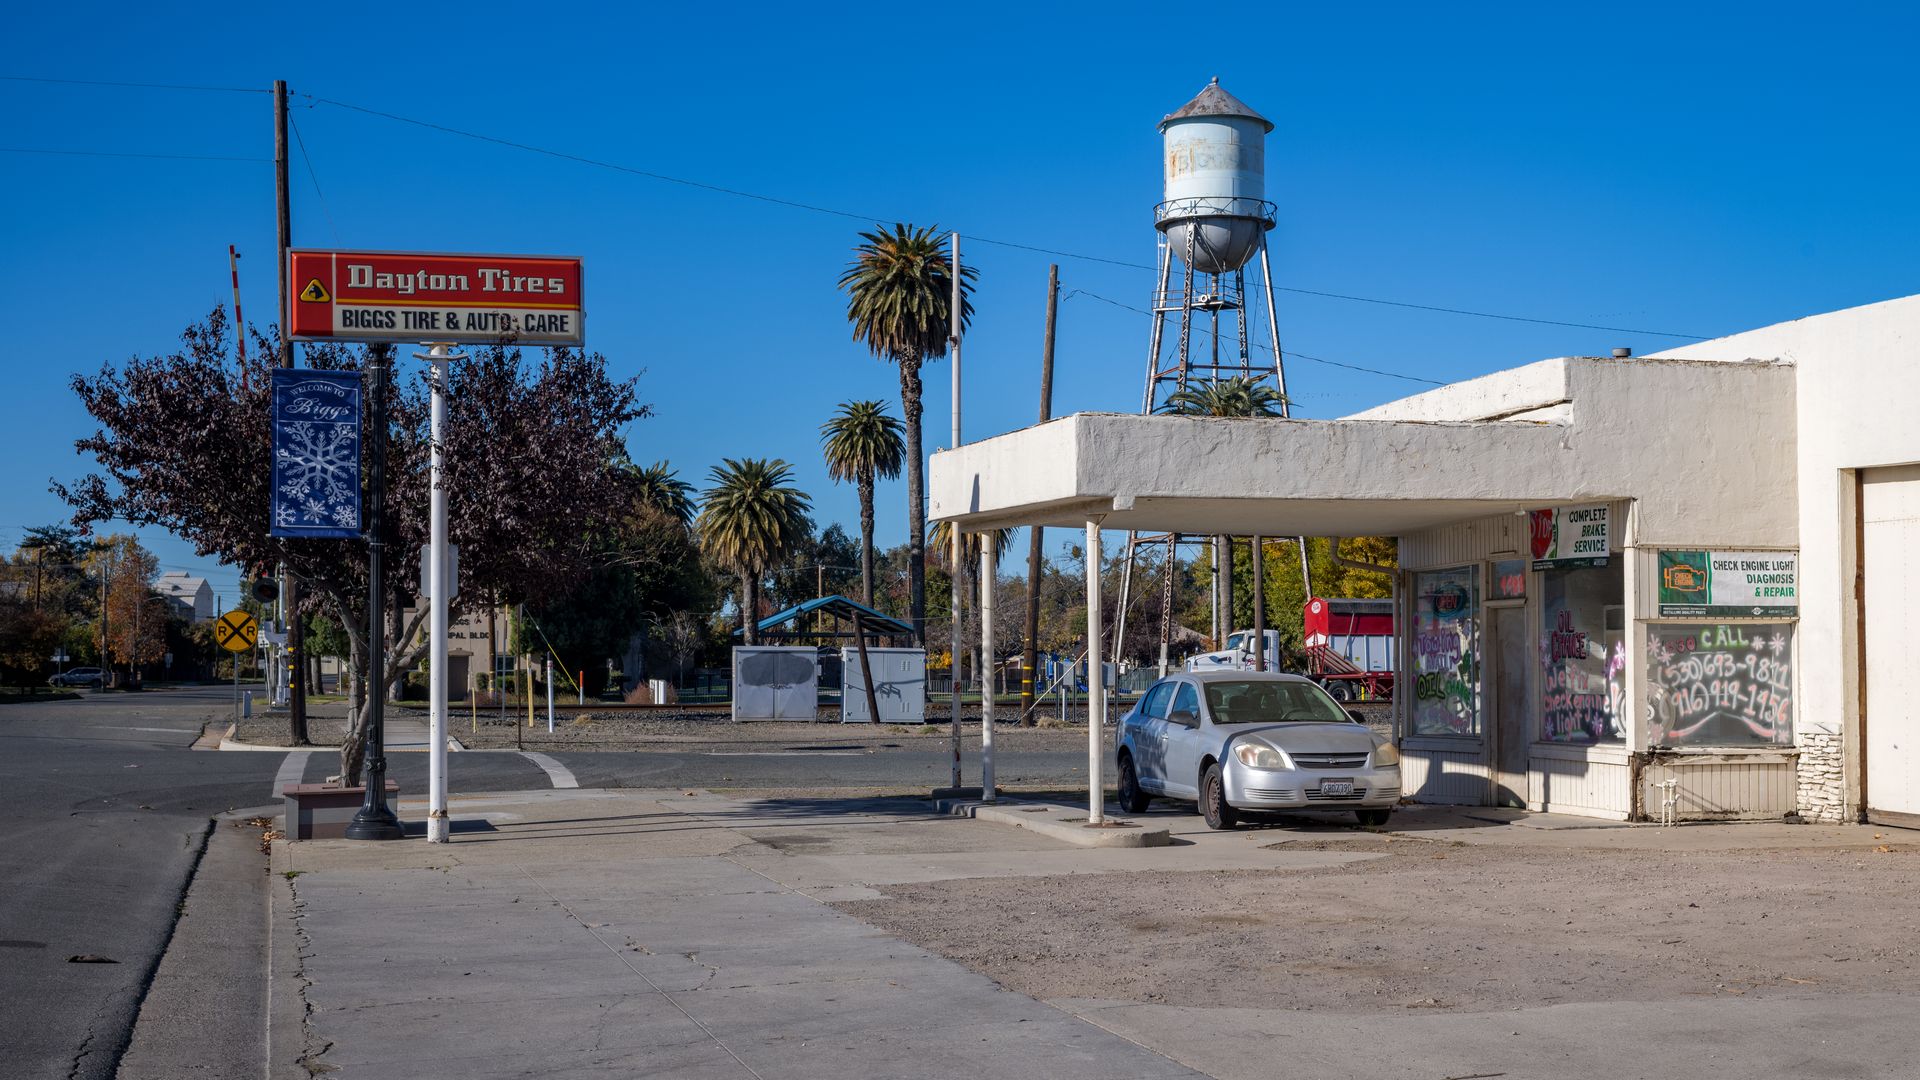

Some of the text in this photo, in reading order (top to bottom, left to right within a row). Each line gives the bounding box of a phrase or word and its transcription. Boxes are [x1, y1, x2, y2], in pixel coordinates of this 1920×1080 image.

[347, 264, 565, 295] Dayton Tires
[342, 309, 570, 333] BIGGS TIRE & AUTO CARE
[289, 384, 345, 398] WELCOME TO
[284, 397, 351, 420] Biggs
[1568, 508, 1607, 523] COMPLETE
[1581, 523, 1607, 537] BRAKE
[1573, 539, 1606, 553] SERVICE
[1713, 560, 1794, 571] CHECK ENGINE LIGHT
[1747, 574, 1795, 584] DIAGNOSIS
[1754, 587, 1795, 598] & REPAIR
[218, 626, 255, 636] R R
[1557, 611, 1575, 633] OIL
[1418, 629, 1462, 664] Towing
[1551, 630, 1587, 662] CHANGE
[1701, 626, 1749, 648] CALL
[1417, 672, 1446, 700] OIL
[1556, 711, 1583, 742] light
